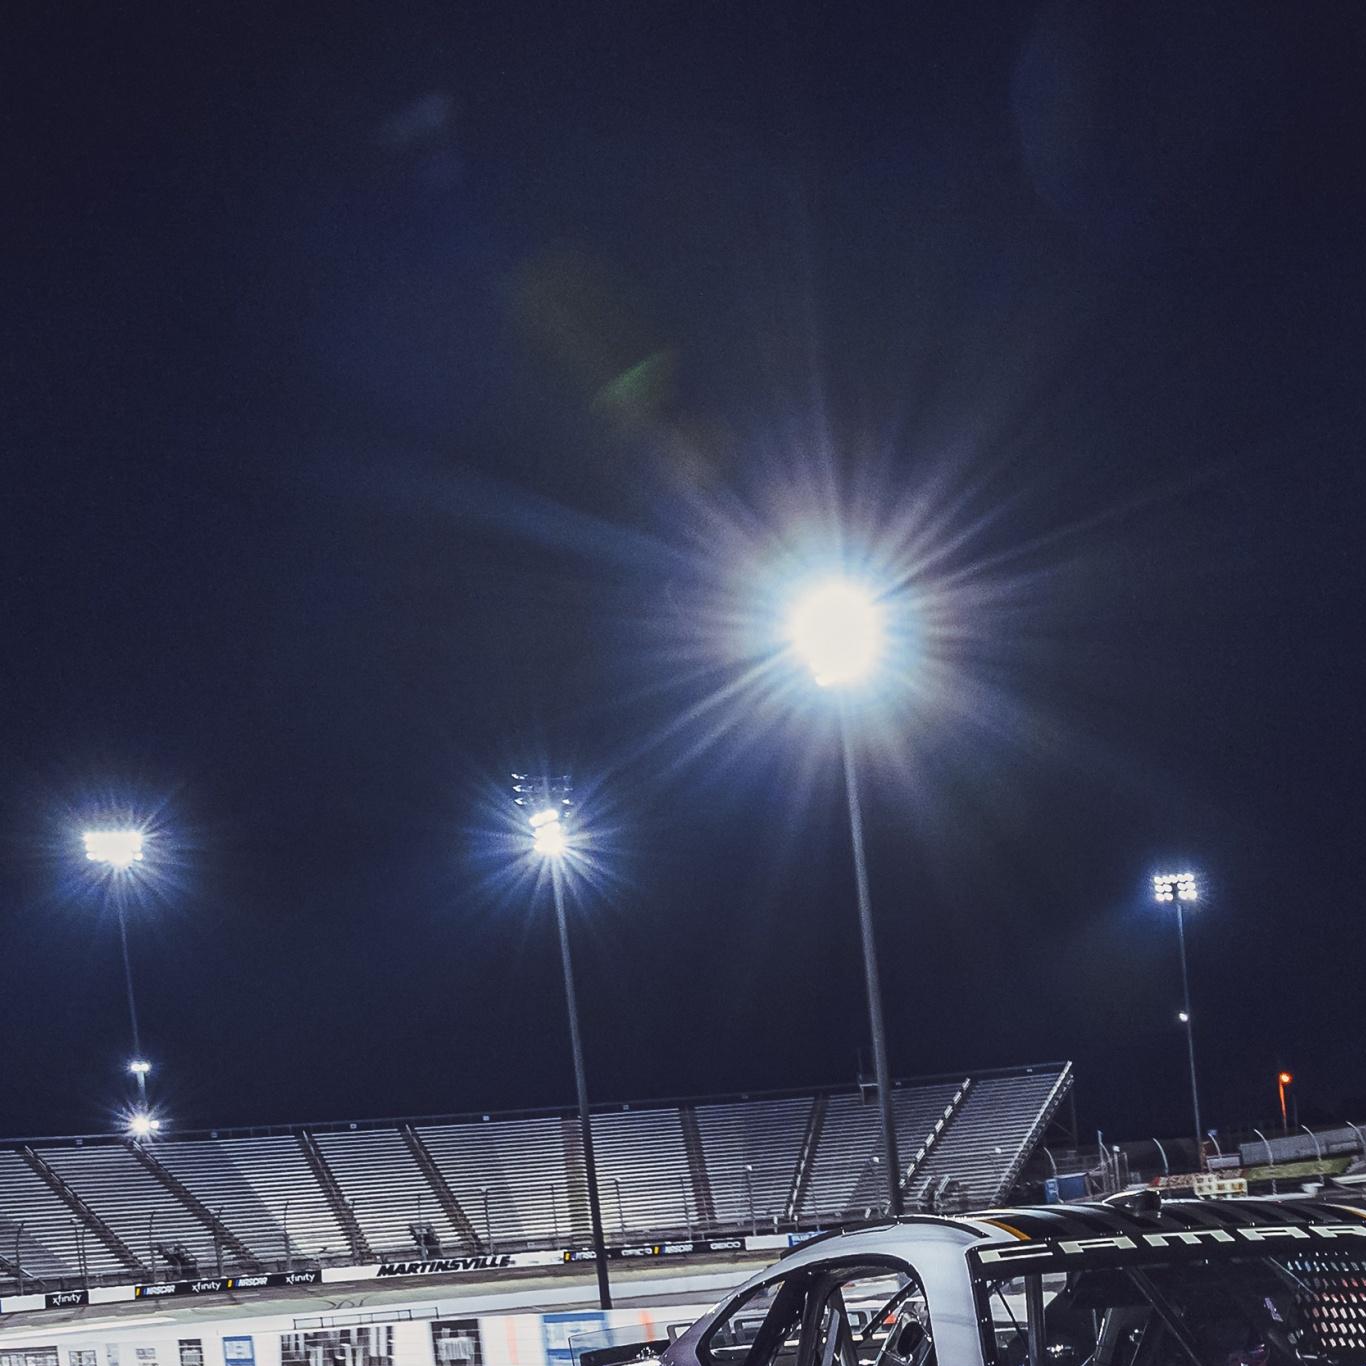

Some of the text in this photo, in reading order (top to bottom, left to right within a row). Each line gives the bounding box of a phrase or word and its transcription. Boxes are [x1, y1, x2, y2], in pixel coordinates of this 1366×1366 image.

[710, 1241, 741, 1250] GEICO
[376, 1255, 511, 1277] MARTINSVILLE
[238, 1273, 315, 1287] NASCAR xfinity
[146, 1281, 221, 1295] NASCAR xfinity
[52, 1294, 82, 1306] xfinity
